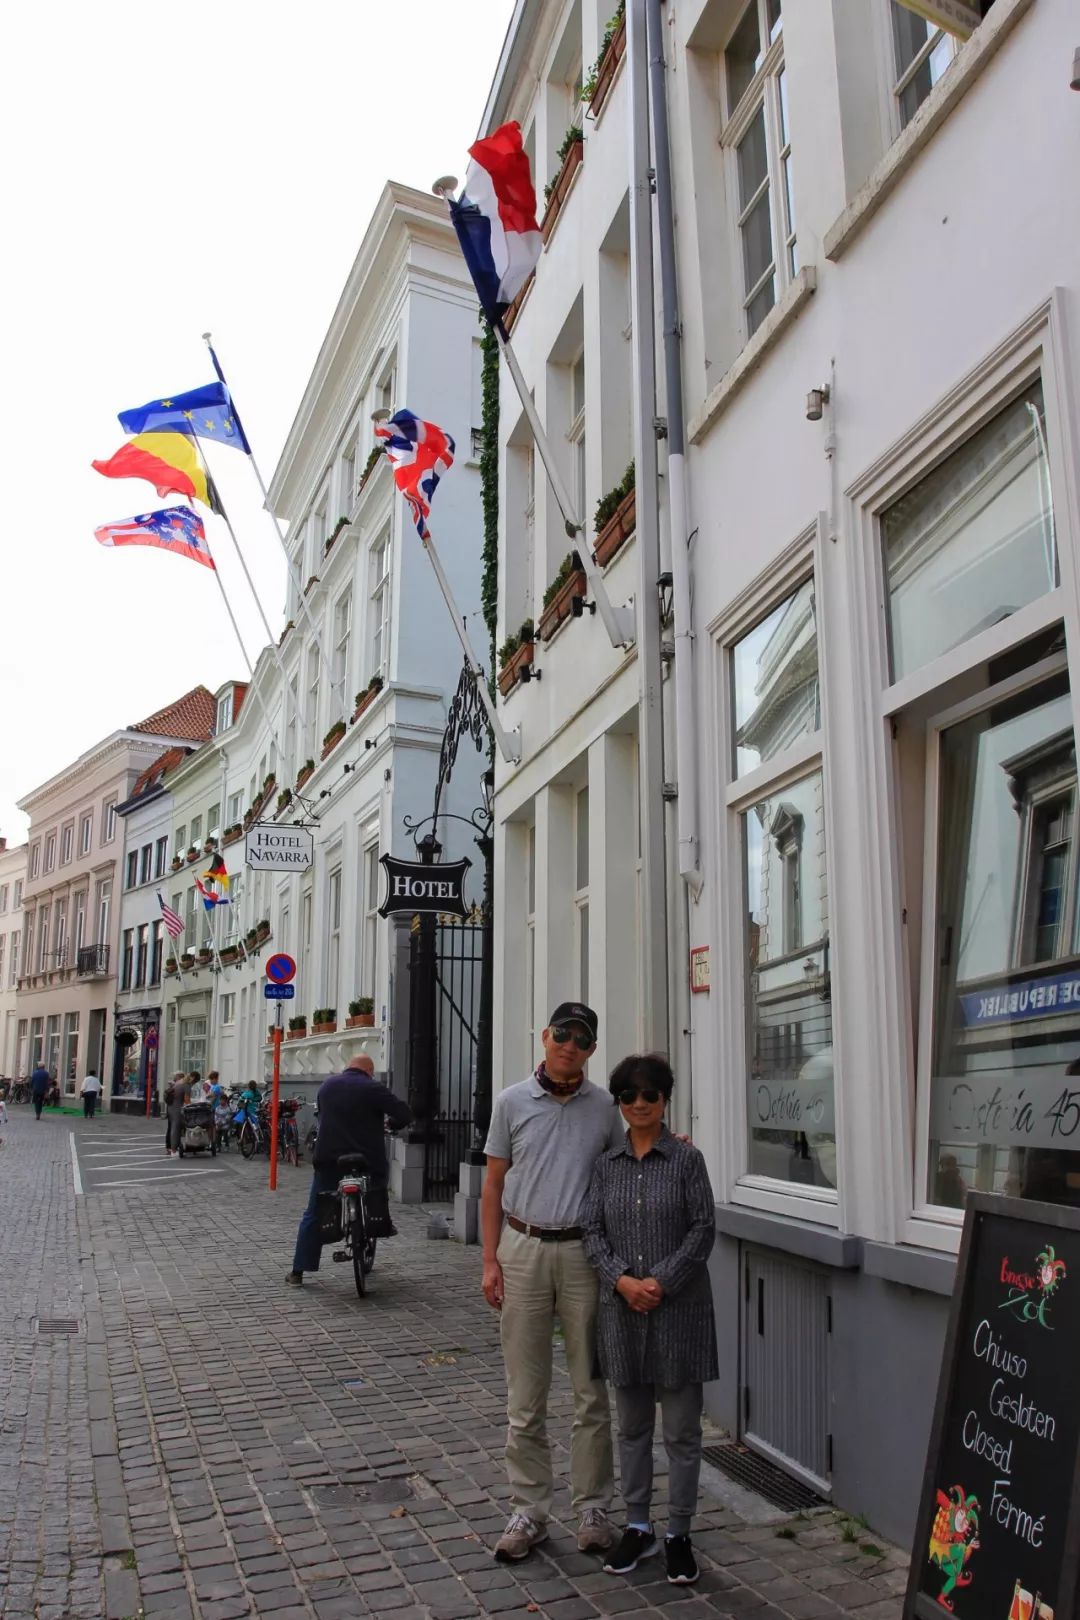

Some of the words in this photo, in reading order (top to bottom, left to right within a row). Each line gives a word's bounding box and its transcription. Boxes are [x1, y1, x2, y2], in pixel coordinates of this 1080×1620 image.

[249, 848, 309, 863] NAVARRA
[257, 833, 303, 848] HOTEL
[392, 875, 459, 899] HOTEL
[949, 1084, 1035, 1137] Osteia
[1043, 1088, 1080, 1138] 45
[998, 1288, 1056, 1331] Zot
[973, 1320, 1027, 1378] Chiuso
[989, 1378, 1056, 1441] Gesloten
[962, 1410, 1012, 1474] Closed
[989, 1480, 1046, 1548] Fermé
